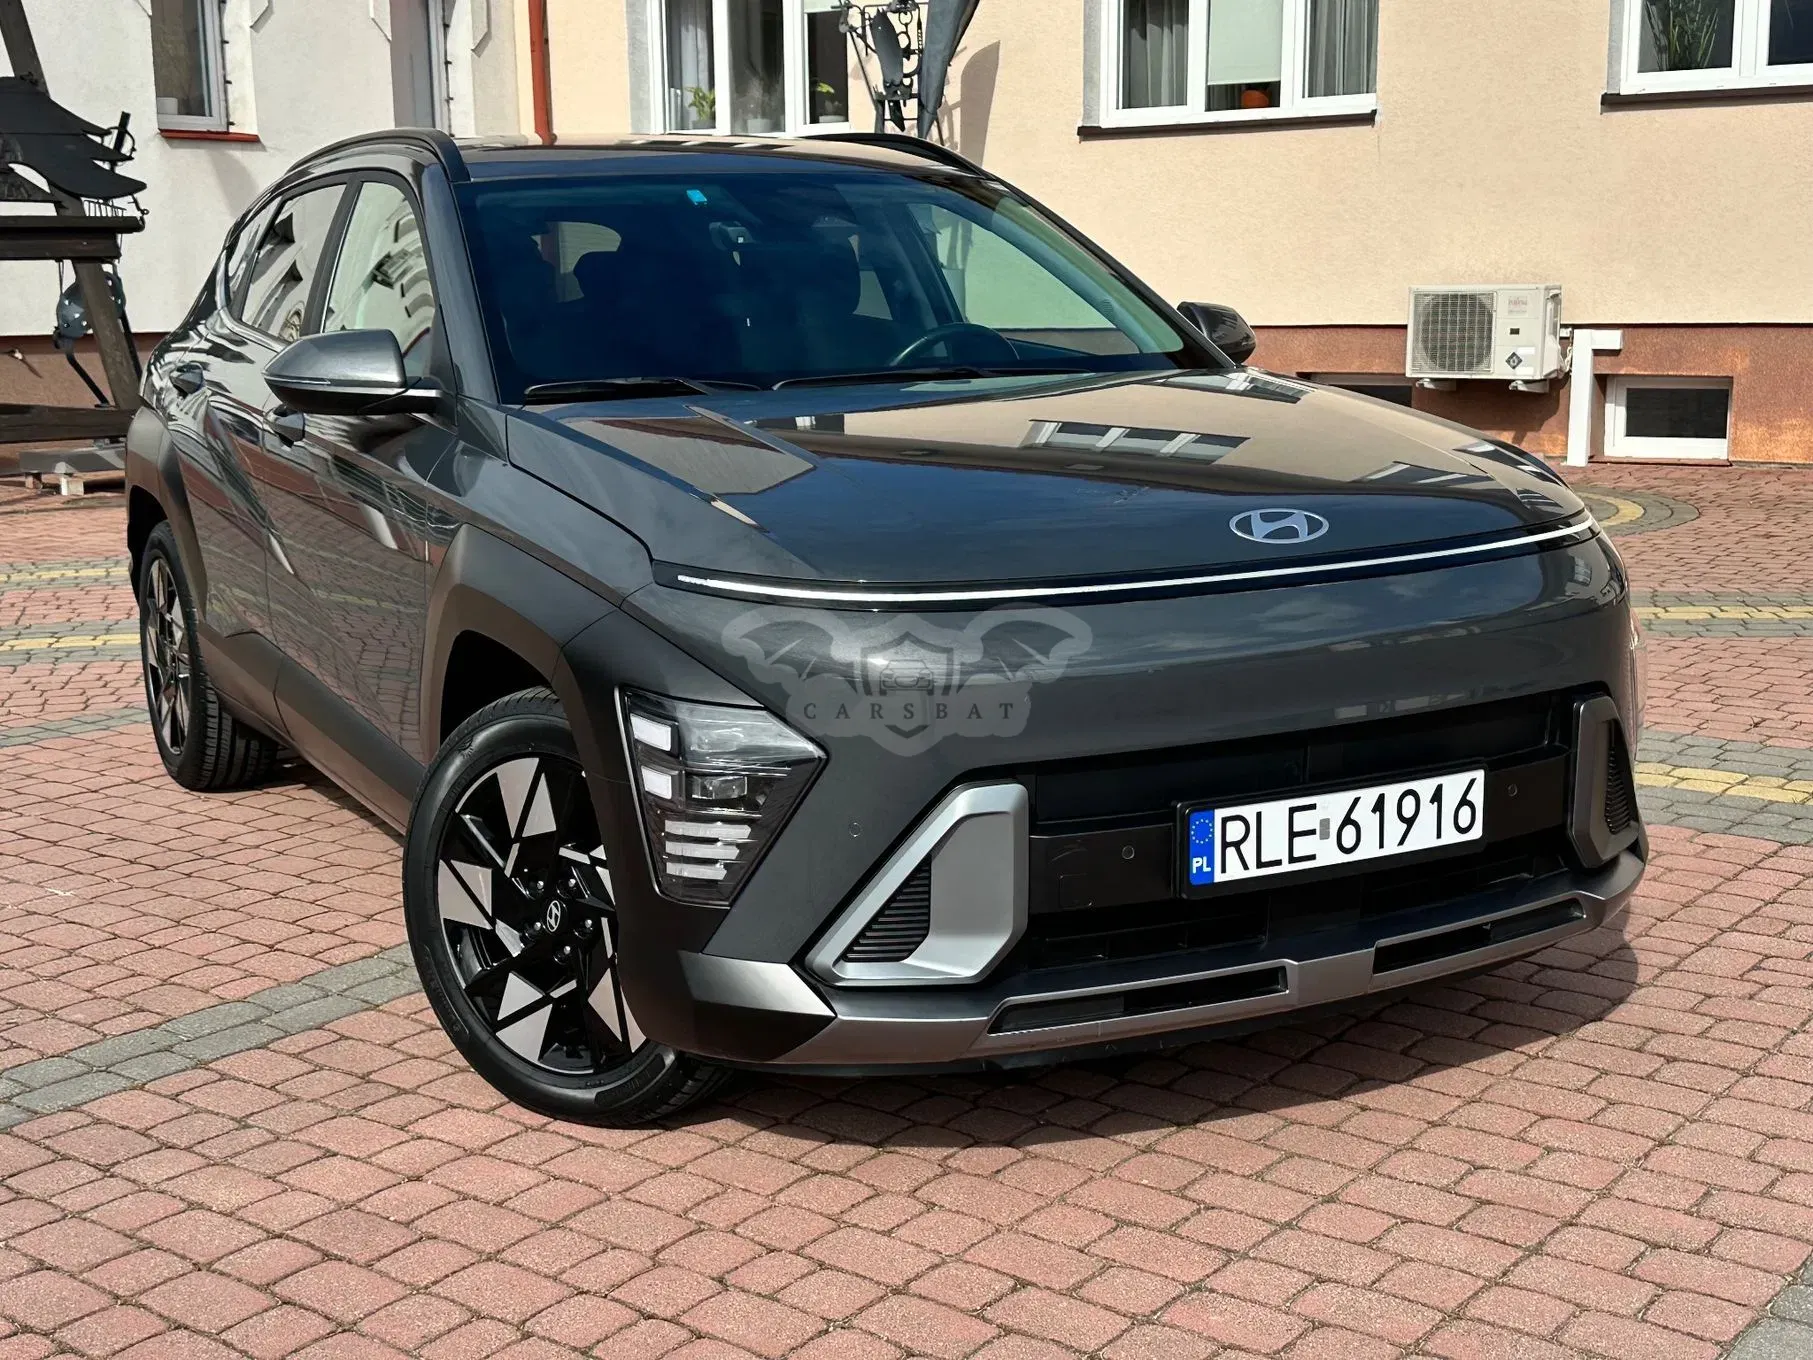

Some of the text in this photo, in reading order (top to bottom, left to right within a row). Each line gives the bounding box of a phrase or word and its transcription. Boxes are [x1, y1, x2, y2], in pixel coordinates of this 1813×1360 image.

[1220, 778, 1477, 874] RLE 61916
[1192, 857, 1212, 874] PL
